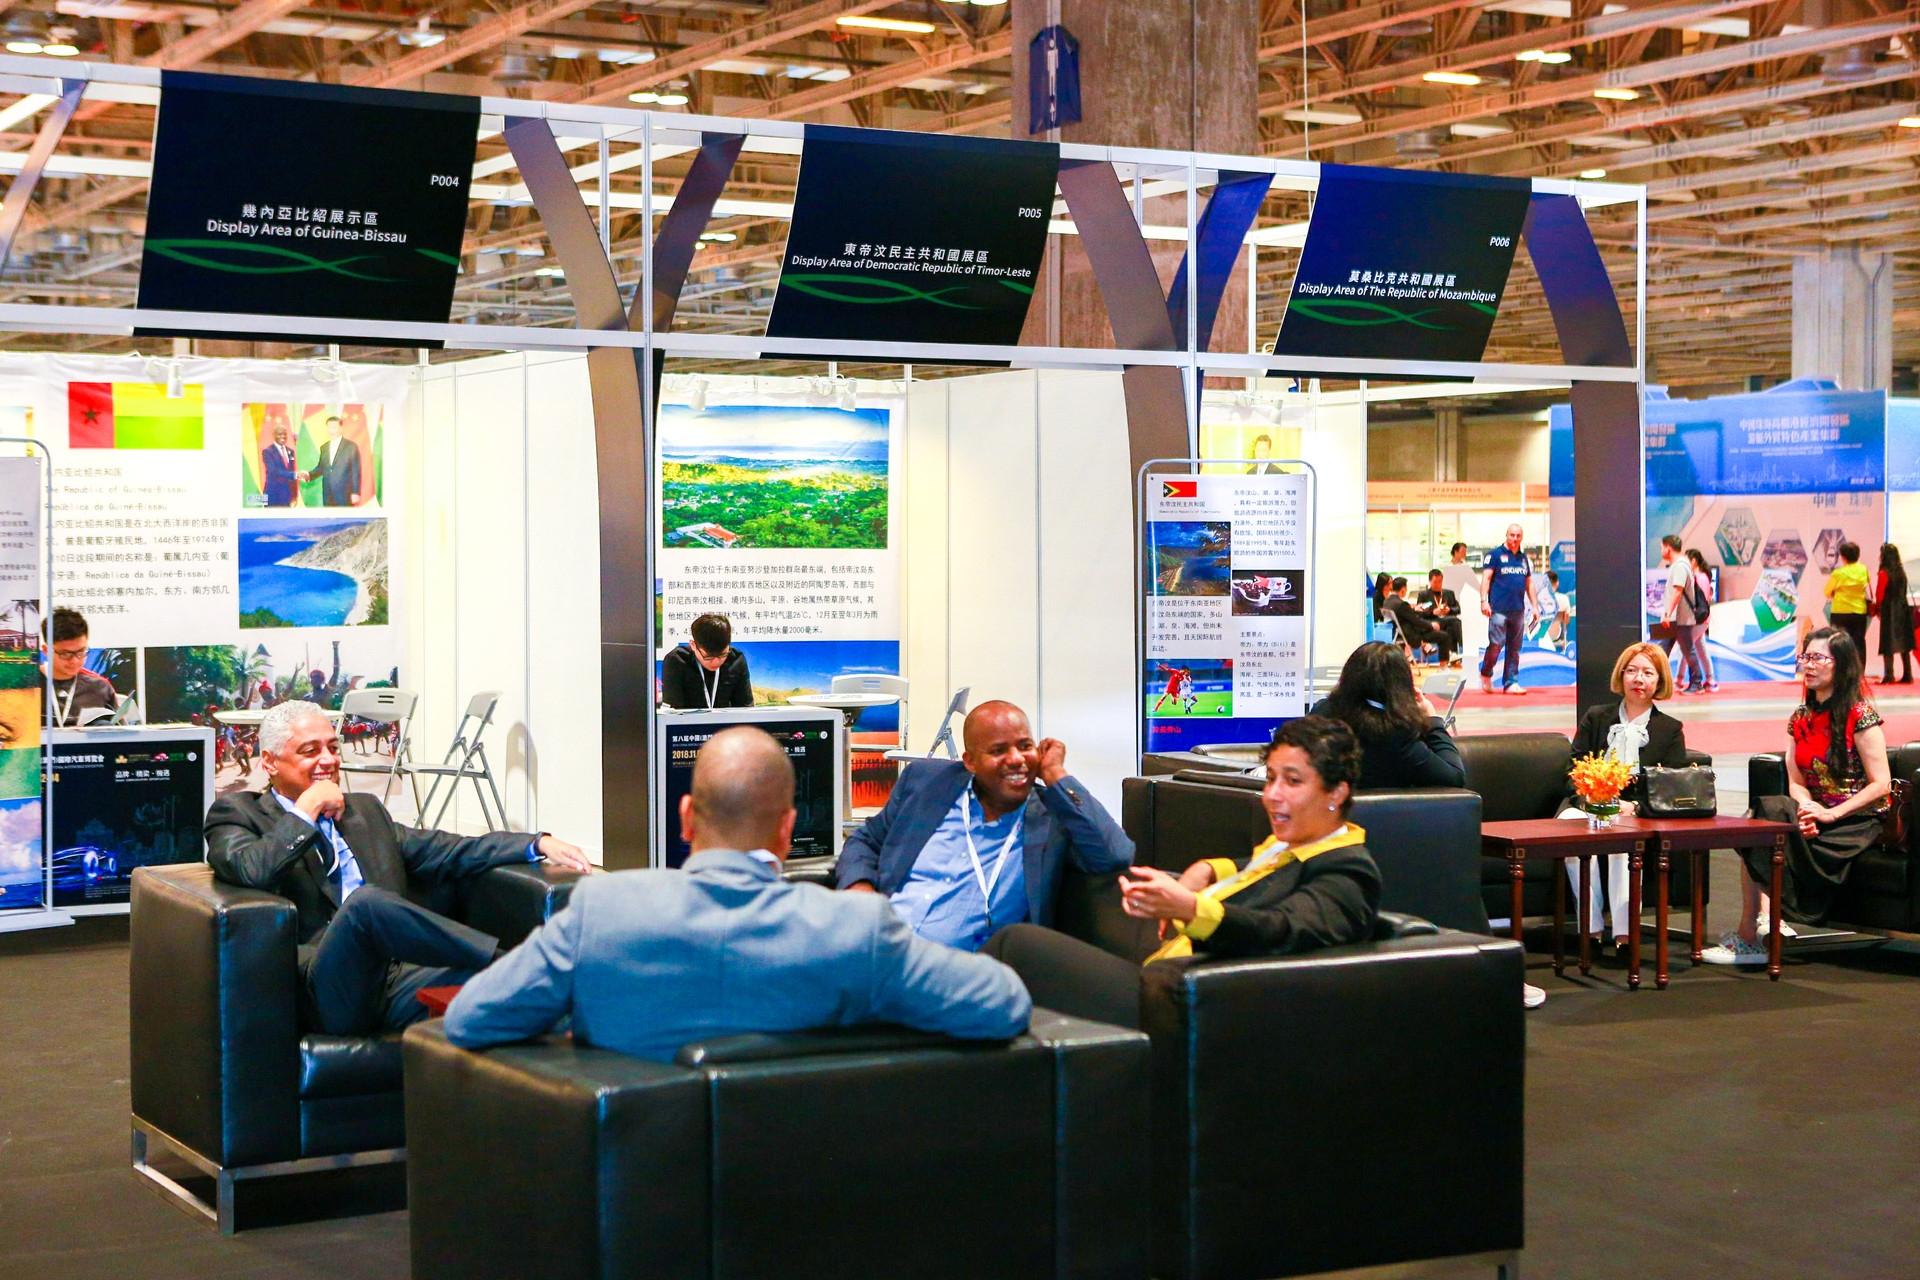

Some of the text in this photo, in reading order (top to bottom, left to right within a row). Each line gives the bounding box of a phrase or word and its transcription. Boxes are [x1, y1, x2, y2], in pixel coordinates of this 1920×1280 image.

[431, 175, 460, 188] P004
[242, 204, 379, 226] 幾內亞比紹展示區
[1018, 208, 1042, 219] P005
[206, 219, 408, 244] Display Area of Guinea-Bissau
[1489, 236, 1510, 247] P006
[843, 243, 990, 263] 東帝汶民主共和國展區
[792, 255, 1032, 278] Display Area of Democratic Republic of Timor-Leste
[1348, 270, 1457, 288] 莫桑比克共和國展區
[1298, 283, 1497, 304] Display Area of The Republic of Mozambique
